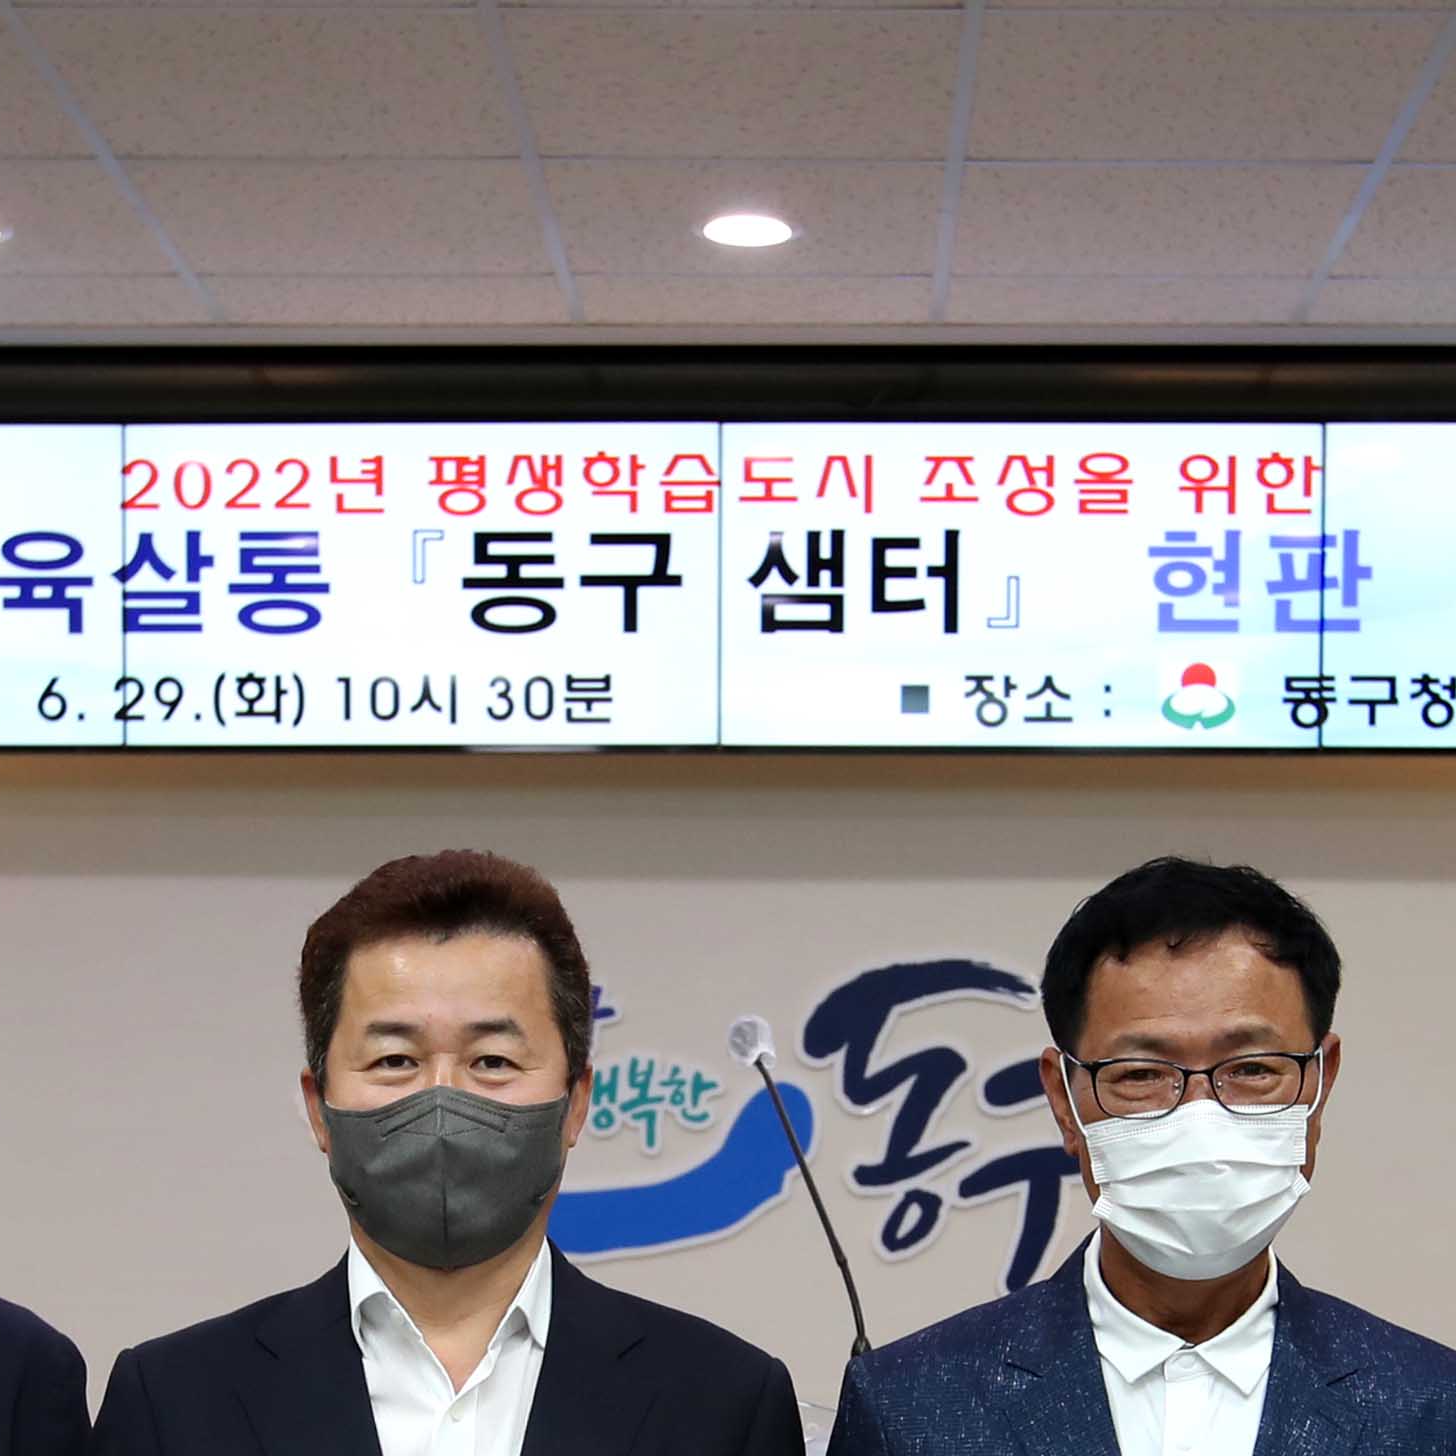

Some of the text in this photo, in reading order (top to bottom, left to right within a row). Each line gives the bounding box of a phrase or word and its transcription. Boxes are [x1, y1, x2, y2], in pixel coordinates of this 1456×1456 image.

[120, 450, 1321, 517] 2022년 평생학습도시 조성을 위한
[1147, 528, 1374, 634] 현판
[113, 671, 305, 727] 29.(화)
[336, 675, 458, 725] 10시
[486, 673, 614, 724] 30분
[963, 673, 1074, 728] 장소
